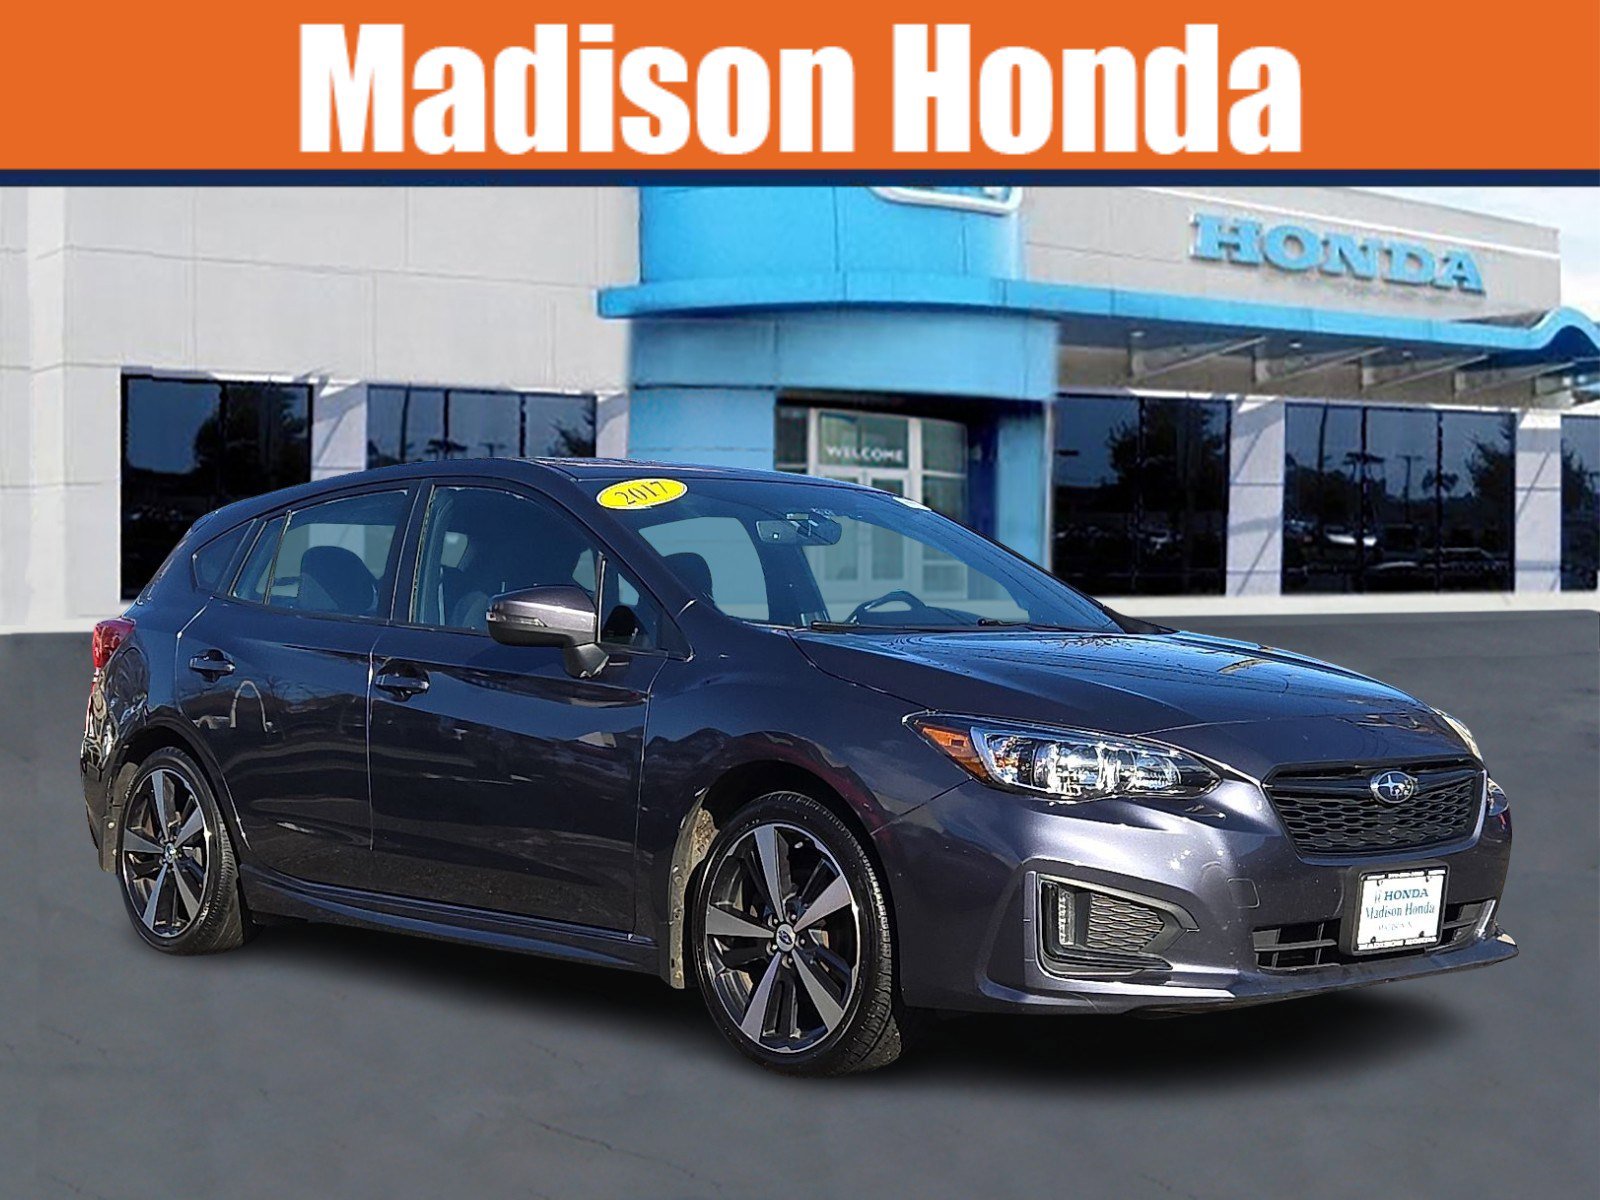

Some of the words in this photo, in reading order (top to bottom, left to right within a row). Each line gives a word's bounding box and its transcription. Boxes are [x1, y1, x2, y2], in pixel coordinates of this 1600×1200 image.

[1190, 212, 1486, 294] HONDA
[826, 445, 905, 463] WELCOME
[614, 481, 669, 505] 2017
[1384, 888, 1429, 901] HONDA
[1365, 905, 1402, 919] Madison
[1405, 902, 1435, 916] Honda
